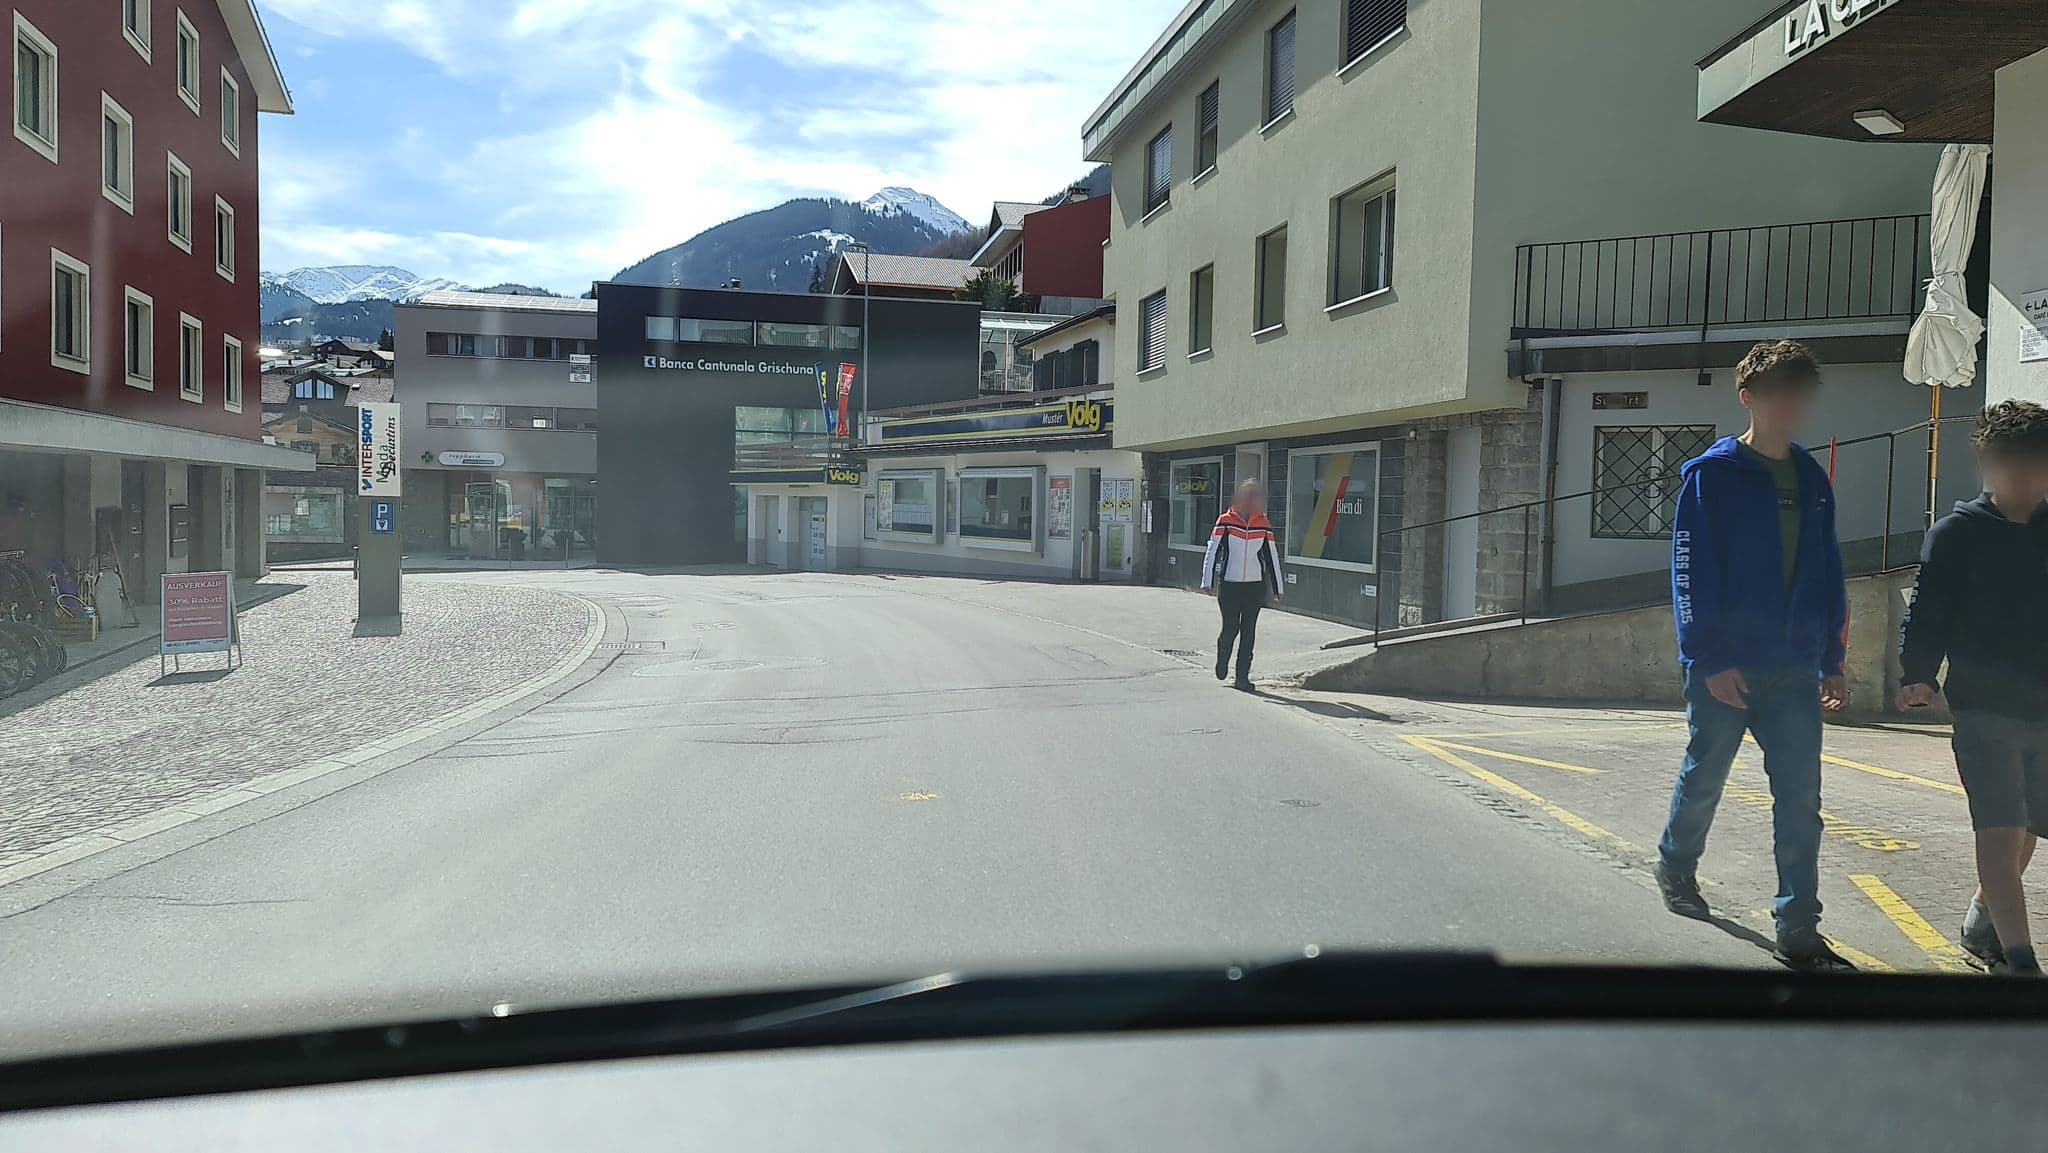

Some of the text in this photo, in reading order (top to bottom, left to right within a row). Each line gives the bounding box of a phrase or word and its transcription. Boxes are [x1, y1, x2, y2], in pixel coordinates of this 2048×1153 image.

[1785, 0, 1825, 54] LA
[659, 357, 814, 375] Banca Cantunala Grischuna
[1066, 400, 1100, 431] Volg
[362, 408, 372, 477] INTERSPORT
[376, 444, 389, 483] Moda
[829, 470, 858, 483] Volg
[377, 504, 388, 518] P
[1336, 498, 1362, 515] Bien di
[167, 580, 224, 591] AUSVERKAUF
[1676, 531, 1693, 624] CLASS OF 2025
[191, 596, 224, 605] Rabatt
